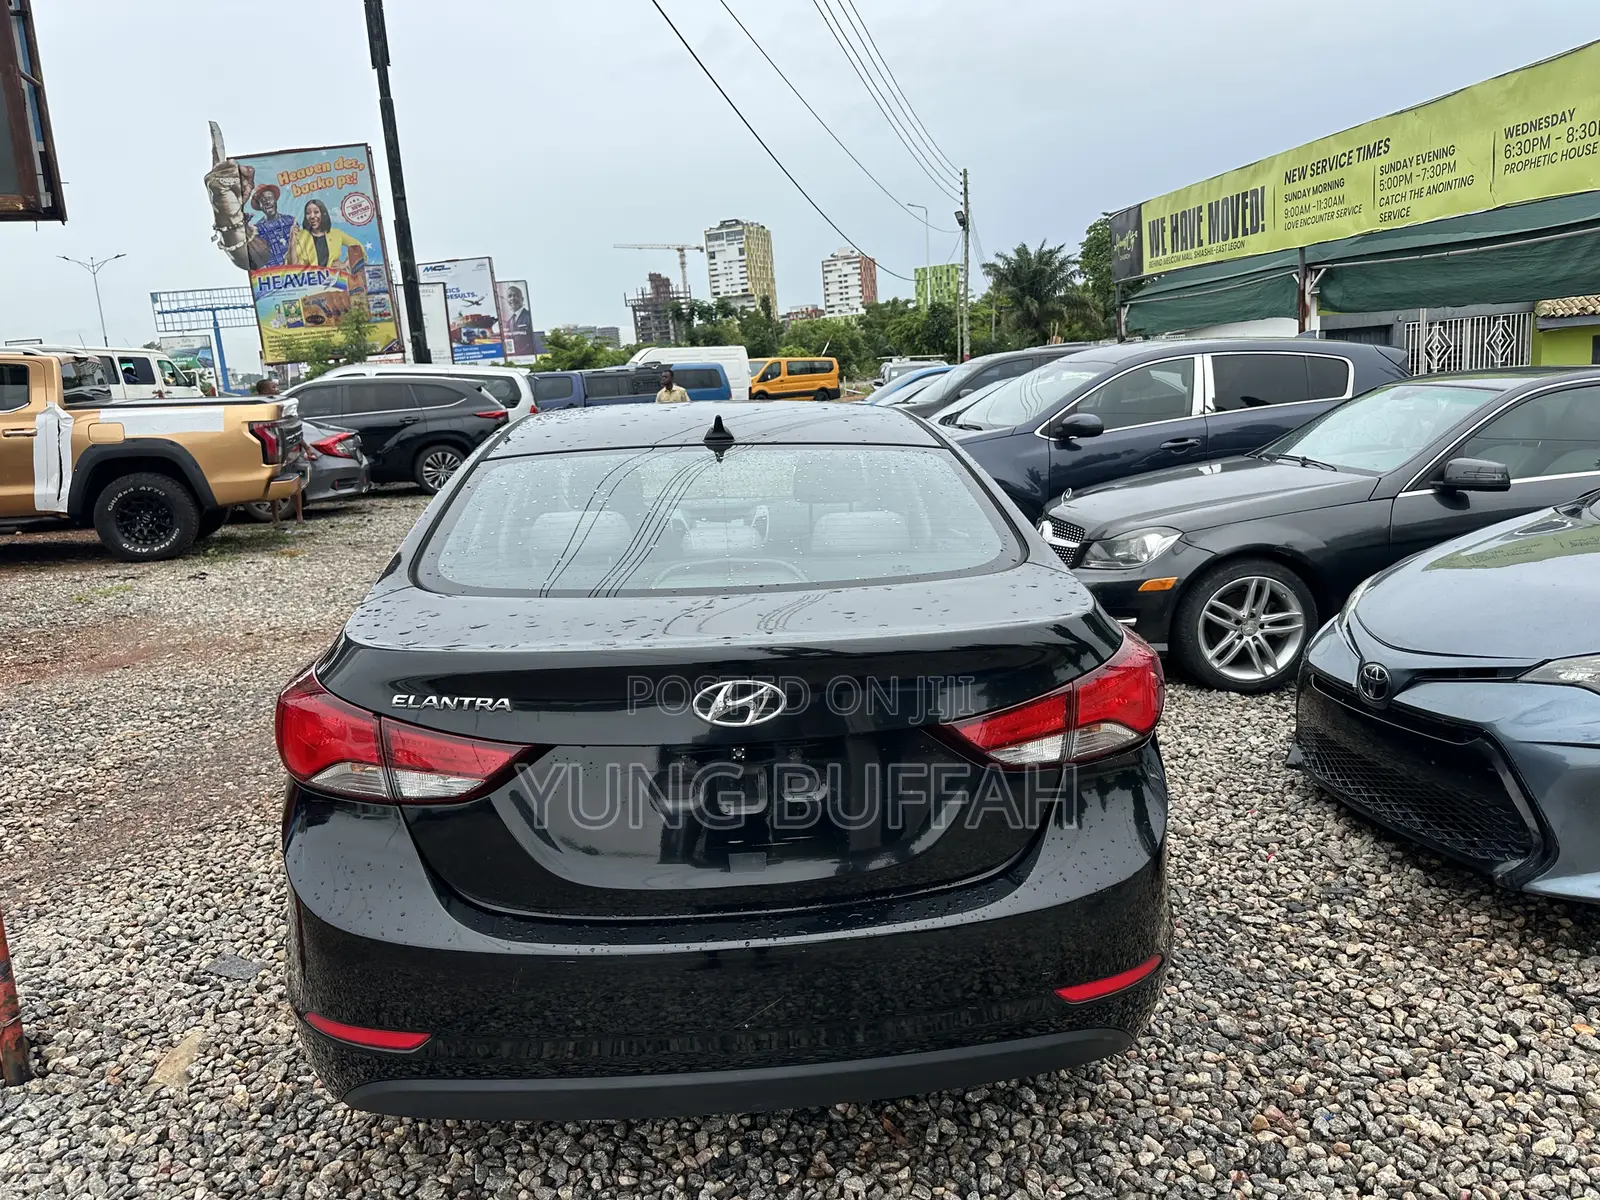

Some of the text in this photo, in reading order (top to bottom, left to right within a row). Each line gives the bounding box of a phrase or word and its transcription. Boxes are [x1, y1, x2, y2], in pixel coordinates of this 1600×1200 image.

[1504, 107, 1576, 140] WEDNESDAY
[1504, 133, 1551, 159] 6:30PM
[1504, 141, 1599, 176] PROPHETIC HOUSE
[1284, 137, 1391, 186] NEW SERVICE TIMES
[1379, 144, 1456, 176] SUNDAY EVENING
[277, 162, 331, 187] Heaven
[291, 176, 334, 198] baako
[1379, 172, 1413, 192] 5:00PM
[1284, 177, 1345, 203] SUNDAY MORNING
[1379, 174, 1475, 208] CATCH THE ANOINTING
[1148, 217, 1167, 259] WE
[1170, 205, 1203, 254] HAVE
[1208, 185, 1266, 246] MOVED!
[1284, 205, 1311, 219] 9:00AM
[1284, 204, 1363, 231] LOVE ENCOUNTER SERVICE
[1379, 206, 1411, 223] SERVICE
[1228, 240, 1246, 249] LEGON
[258, 270, 330, 291] HEAVEN
[139, 486, 166, 496] AT70
[122, 542, 150, 553] AT70
[391, 694, 513, 712] ELANTRA
